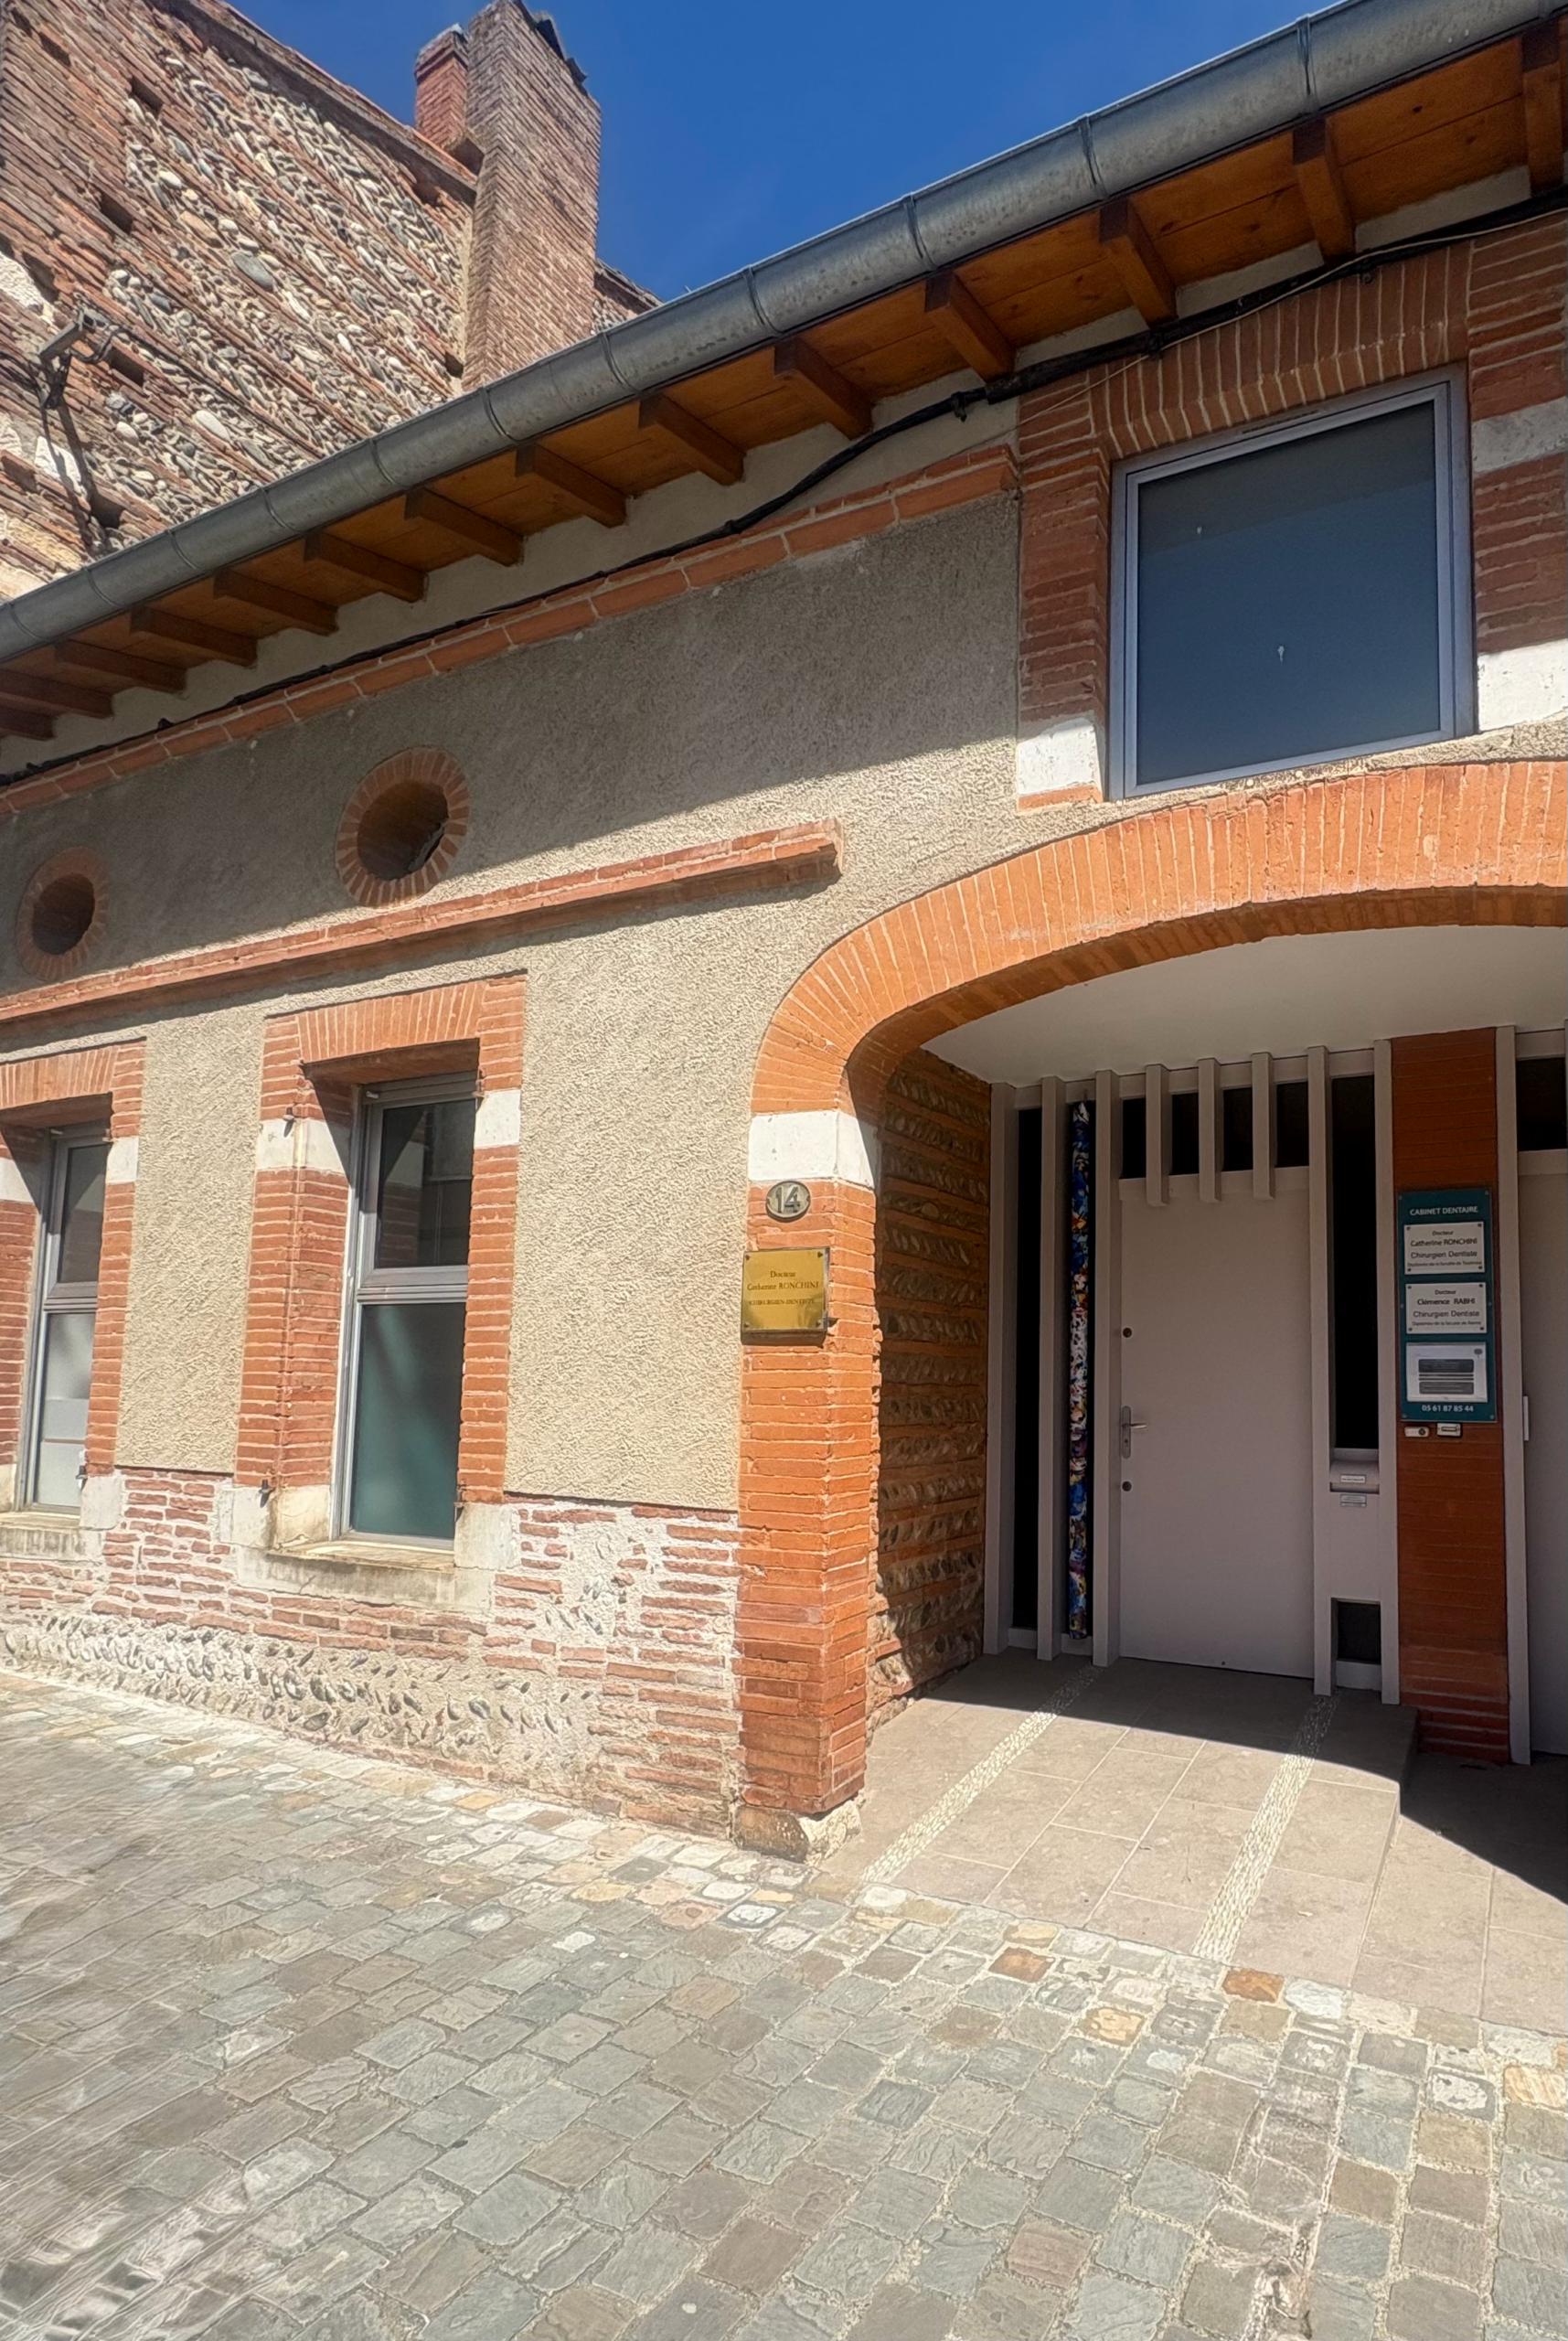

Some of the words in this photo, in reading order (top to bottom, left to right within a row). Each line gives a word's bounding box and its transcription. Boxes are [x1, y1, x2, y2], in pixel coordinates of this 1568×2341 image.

[775, 1186, 800, 1213] 14
[1410, 1207, 1441, 1216] CABINET
[1442, 1205, 1478, 1214] DENTAIRE
[1411, 1239, 1442, 1247] Catherine
[1444, 1237, 1477, 1245] RONCHINI
[1411, 1251, 1446, 1259] Chirurgien
[778, 1281, 819, 1289] RONCHINI
[1413, 1310, 1449, 1319] Chirurgien
